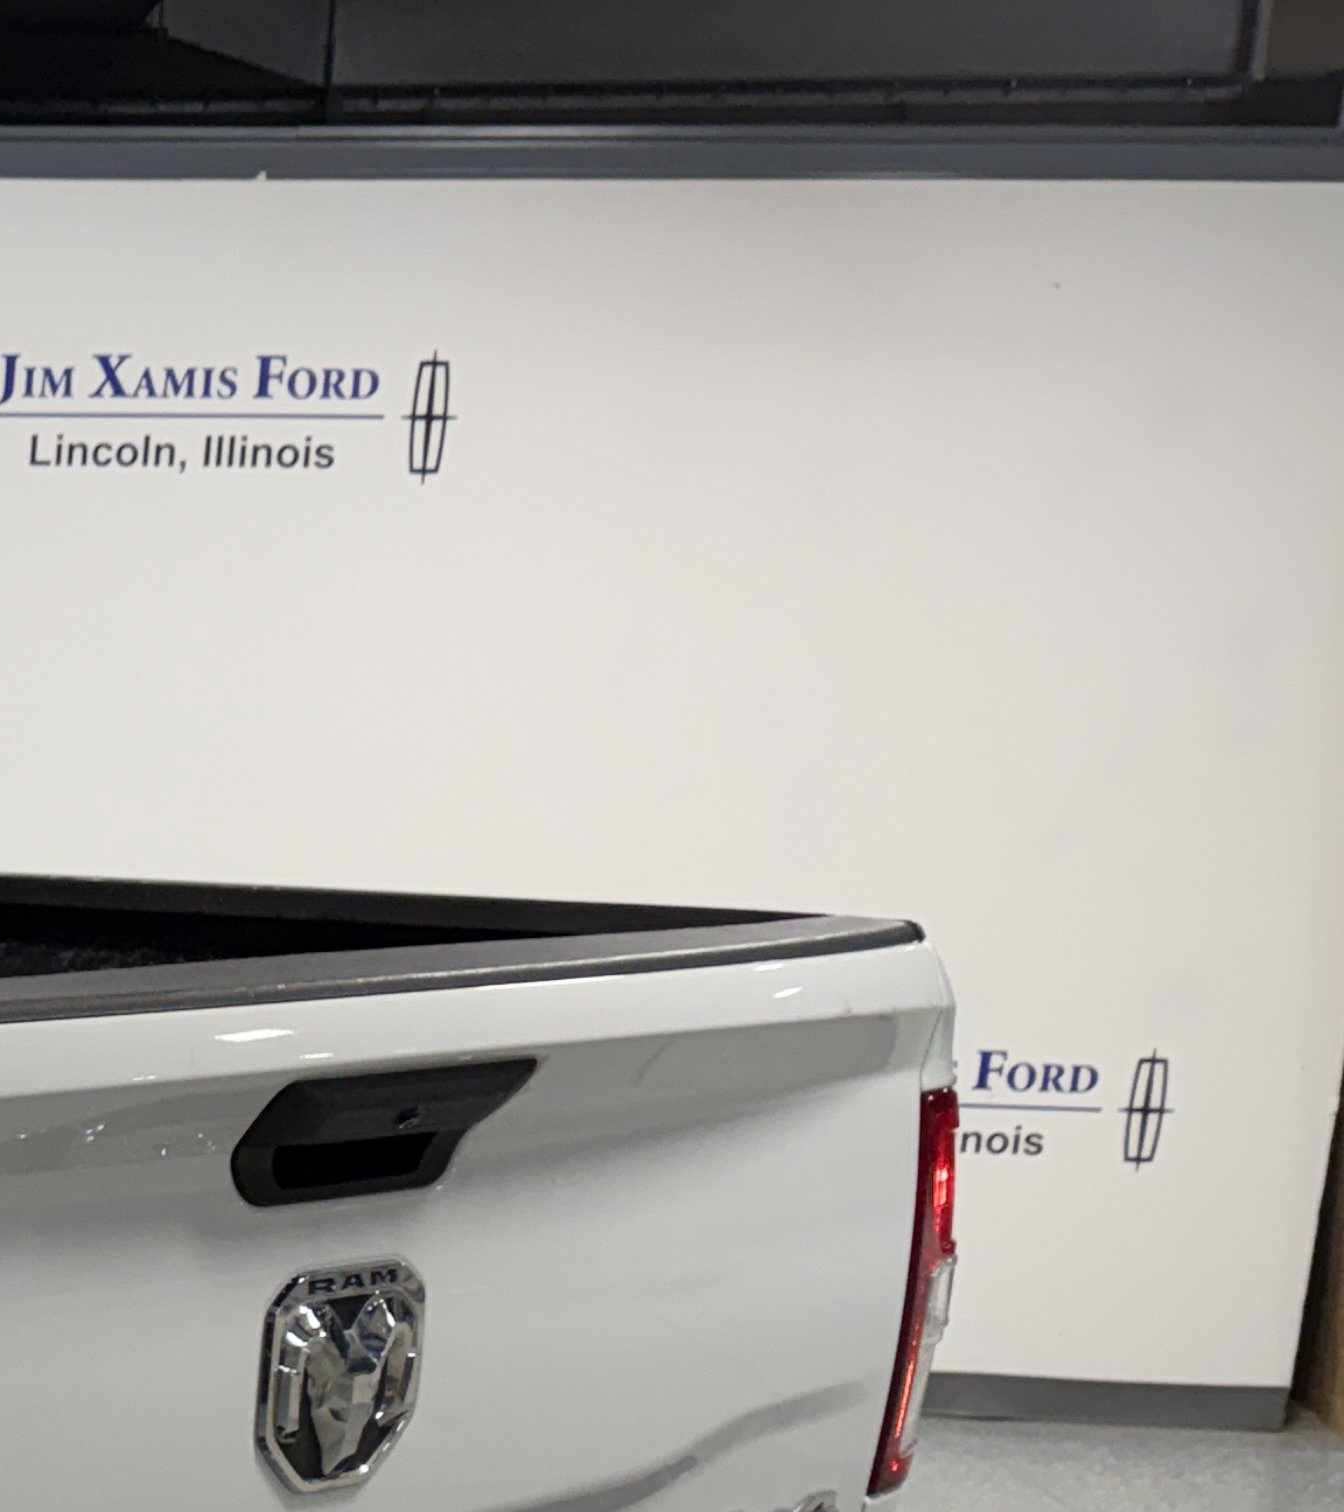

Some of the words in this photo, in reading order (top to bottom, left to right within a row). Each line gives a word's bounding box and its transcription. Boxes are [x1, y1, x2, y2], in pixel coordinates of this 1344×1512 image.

[88, 354, 238, 399] XAMIS
[252, 354, 380, 400] FORD
[29, 433, 186, 474] Lincoln,
[203, 434, 335, 469] Illinois
[972, 1049, 1100, 1094] FORD
[958, 1125, 1045, 1156] nois
[307, 1268, 399, 1296] RAM
